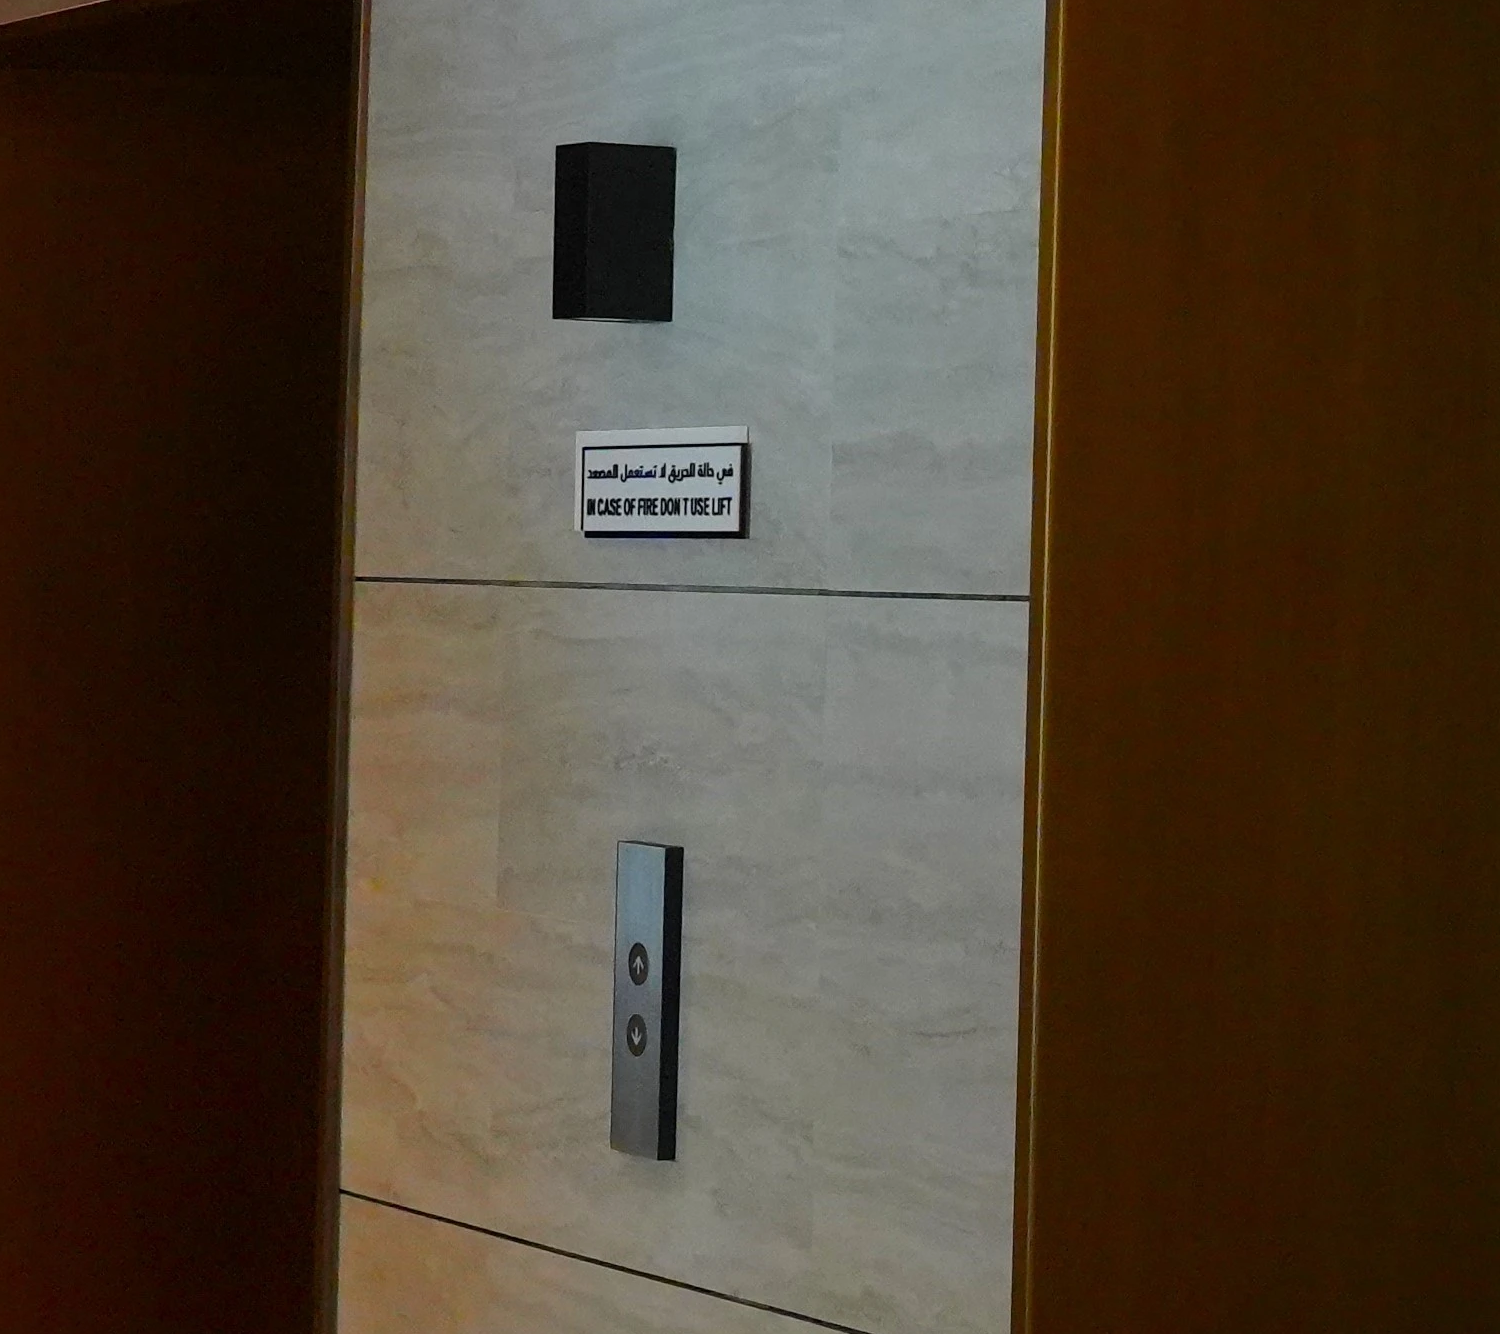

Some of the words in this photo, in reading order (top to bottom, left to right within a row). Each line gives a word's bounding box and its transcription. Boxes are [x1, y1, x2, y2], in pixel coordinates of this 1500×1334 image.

[587, 464, 618, 478] المصعد
[620, 463, 658, 482] تستعمل
[658, 462, 666, 478] لا
[668, 462, 695, 483] الحريق
[697, 462, 714, 477] حالة
[716, 464, 734, 485] في
[586, 498, 596, 516] IN
[597, 498, 622, 516] CASE
[623, 498, 636, 516] OF
[638, 497, 659, 516] FIRE
[690, 497, 710, 516] USE
[712, 496, 732, 516] LIFT
